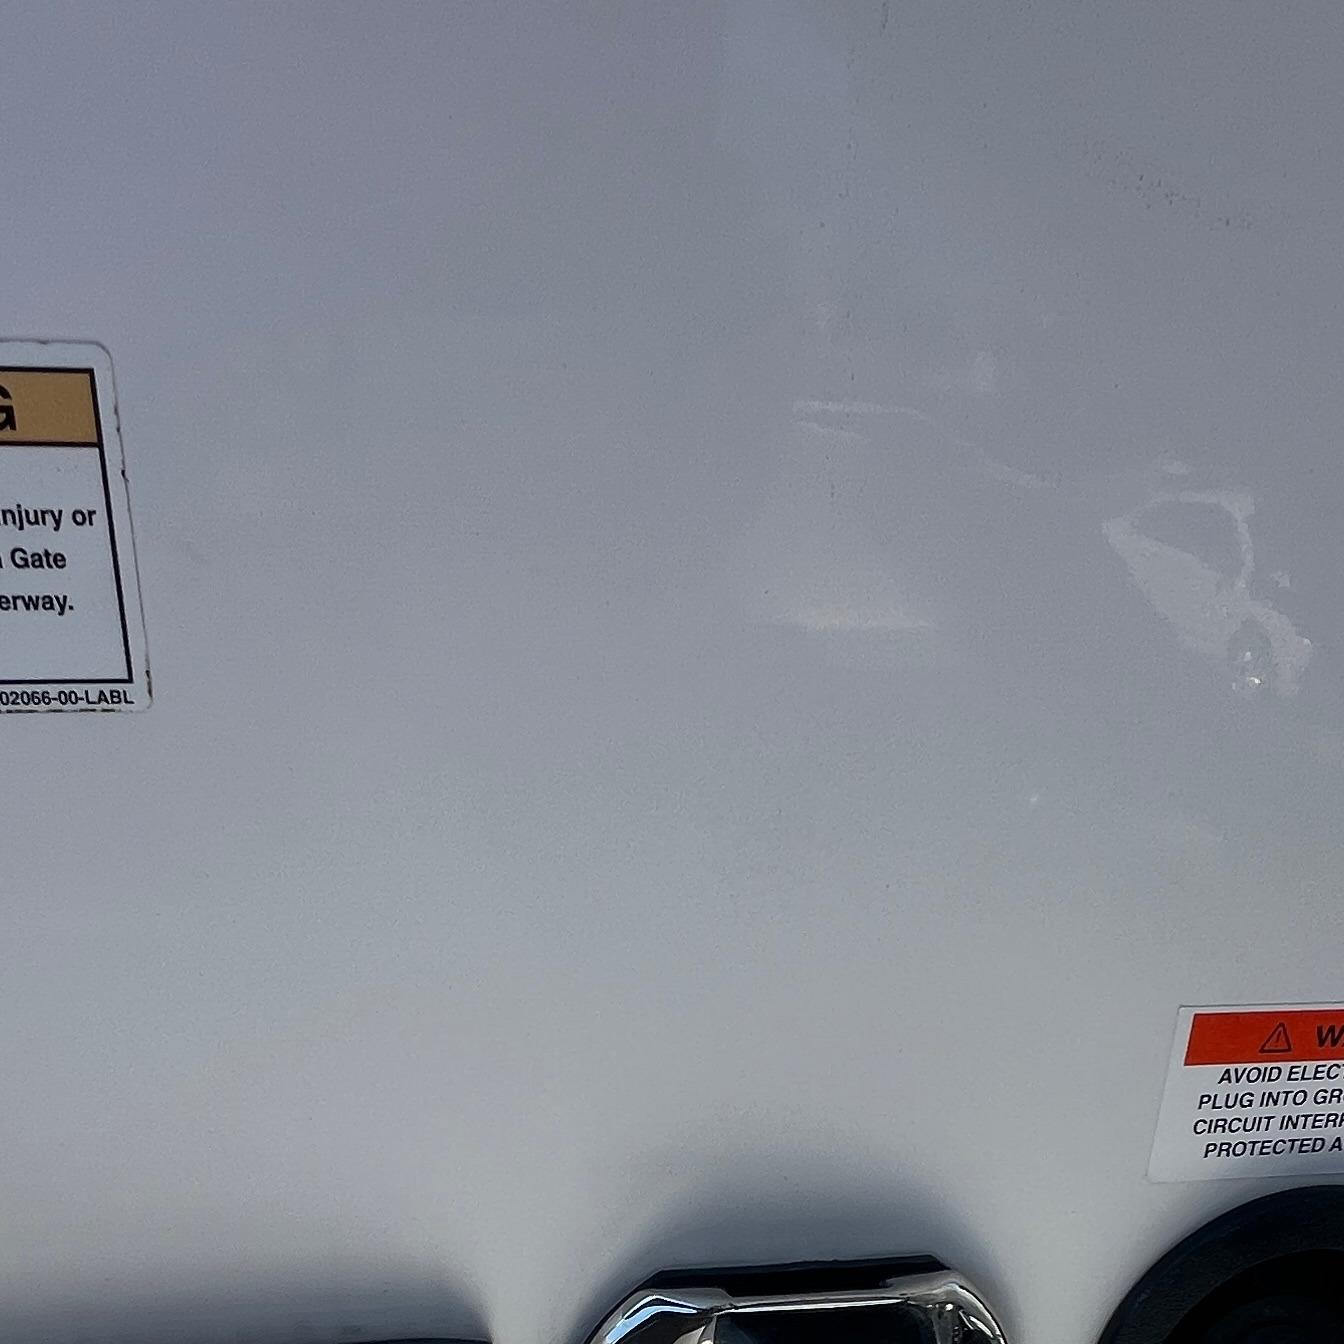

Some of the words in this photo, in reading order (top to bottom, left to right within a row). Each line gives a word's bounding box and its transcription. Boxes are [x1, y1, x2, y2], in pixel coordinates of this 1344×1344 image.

[71, 509, 97, 527] or
[11, 548, 67, 570] Gate
[1218, 1067, 1282, 1084] AVOID
[1198, 1093, 1254, 1110] PLUG
[1259, 1090, 1307, 1107] INTO
[1193, 1115, 1274, 1135] CIRCUIT
[1203, 1138, 1326, 1158] PROTECTED
